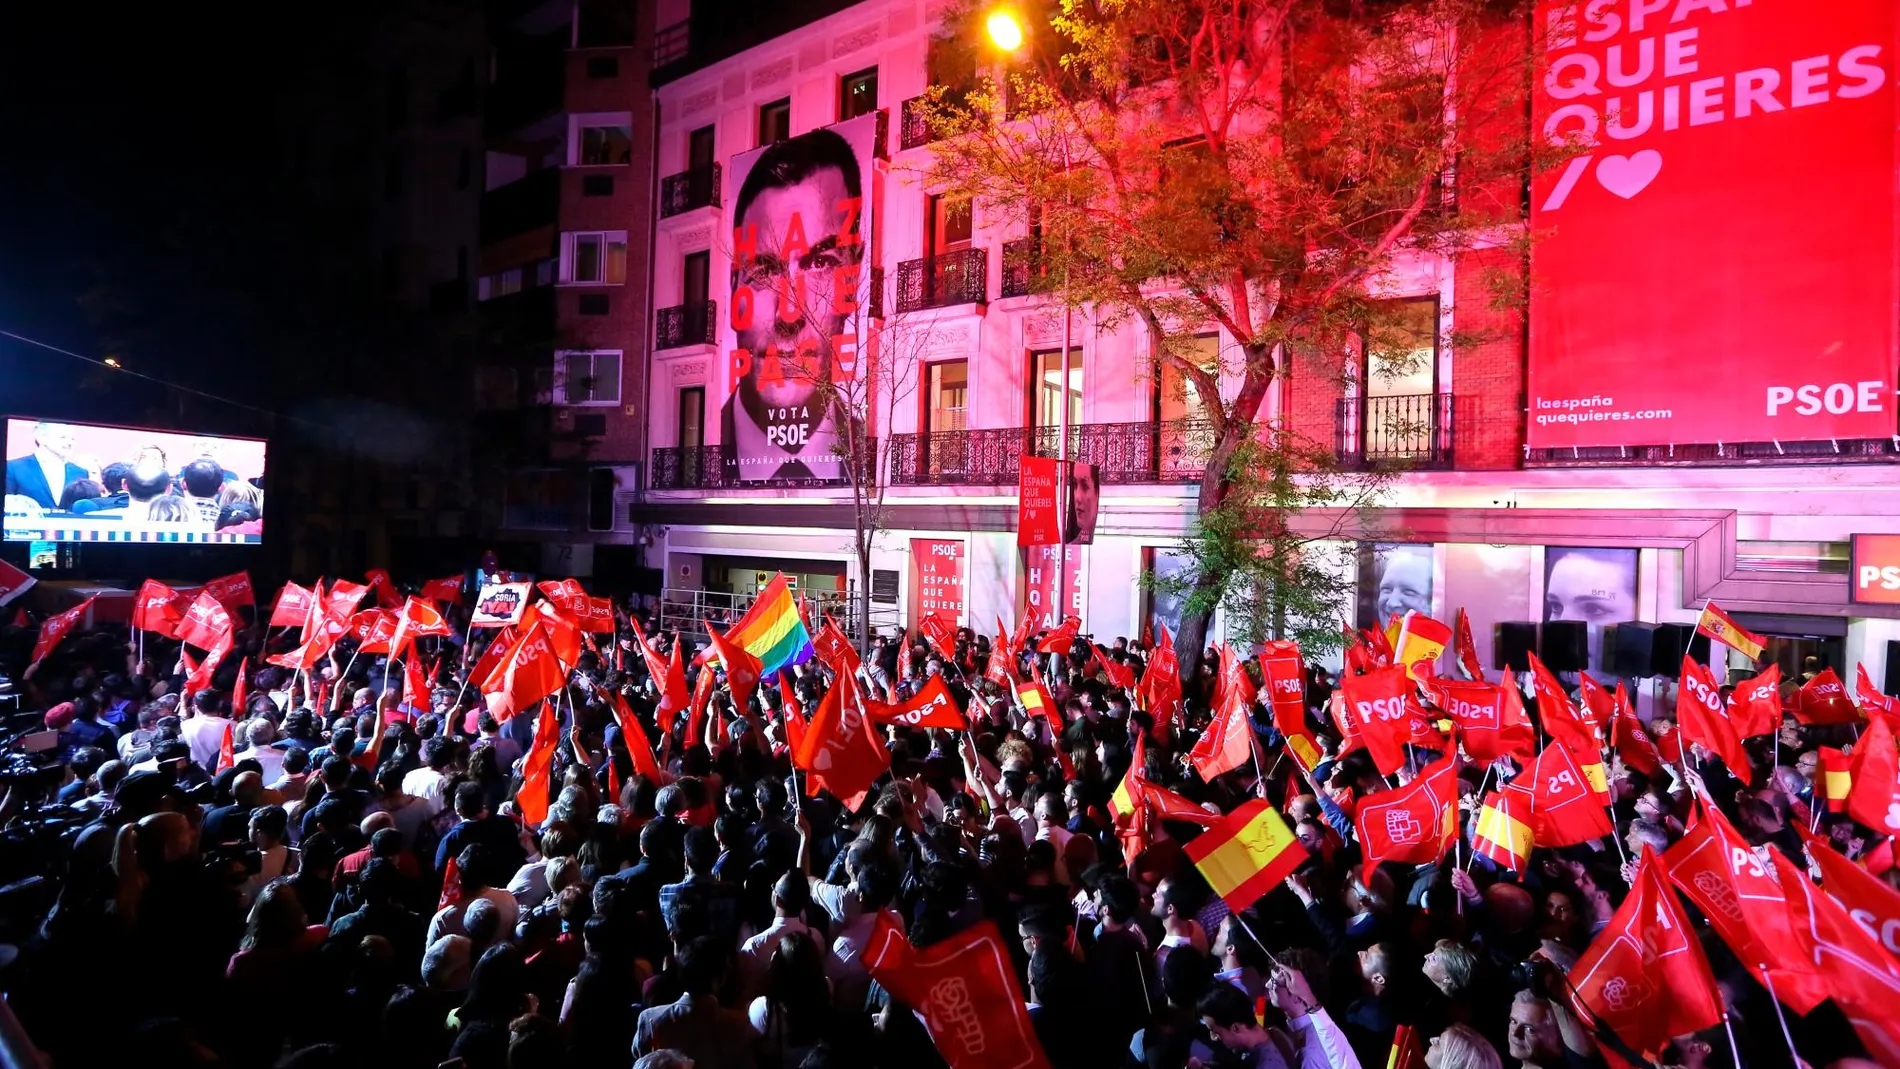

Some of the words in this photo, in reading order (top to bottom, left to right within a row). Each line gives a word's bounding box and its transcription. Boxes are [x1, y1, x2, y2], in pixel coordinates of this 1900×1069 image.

[1543, 27, 1699, 100] QUE
[1541, 45, 1886, 147] QUIERES
[733, 197, 863, 271] HAZ
[730, 264, 861, 332] QUE
[728, 332, 858, 394] PASE
[1536, 395, 1613, 410] laespaña
[1766, 380, 1884, 416] PSOE
[767, 406, 809, 421] VOTA
[1536, 406, 1672, 425] quequieres.com
[767, 423, 809, 447] PSOE
[726, 458, 737, 466] LA
[778, 455, 796, 464] QUE
[1023, 467, 1033, 476] LA
[1023, 475, 1051, 487] ESPAÑA
[1023, 487, 1040, 498] QUE
[1023, 498, 1052, 508] QUIERES
[557, 545, 573, 562] 72
[932, 544, 957, 556] PSOE
[1043, 547, 1073, 560] PSE
[923, 563, 936, 572] LA
[1030, 567, 1081, 586] HZ
[495, 593, 516, 602] SORIA
[923, 588, 943, 597] QUE
[1030, 588, 1081, 608] QE
